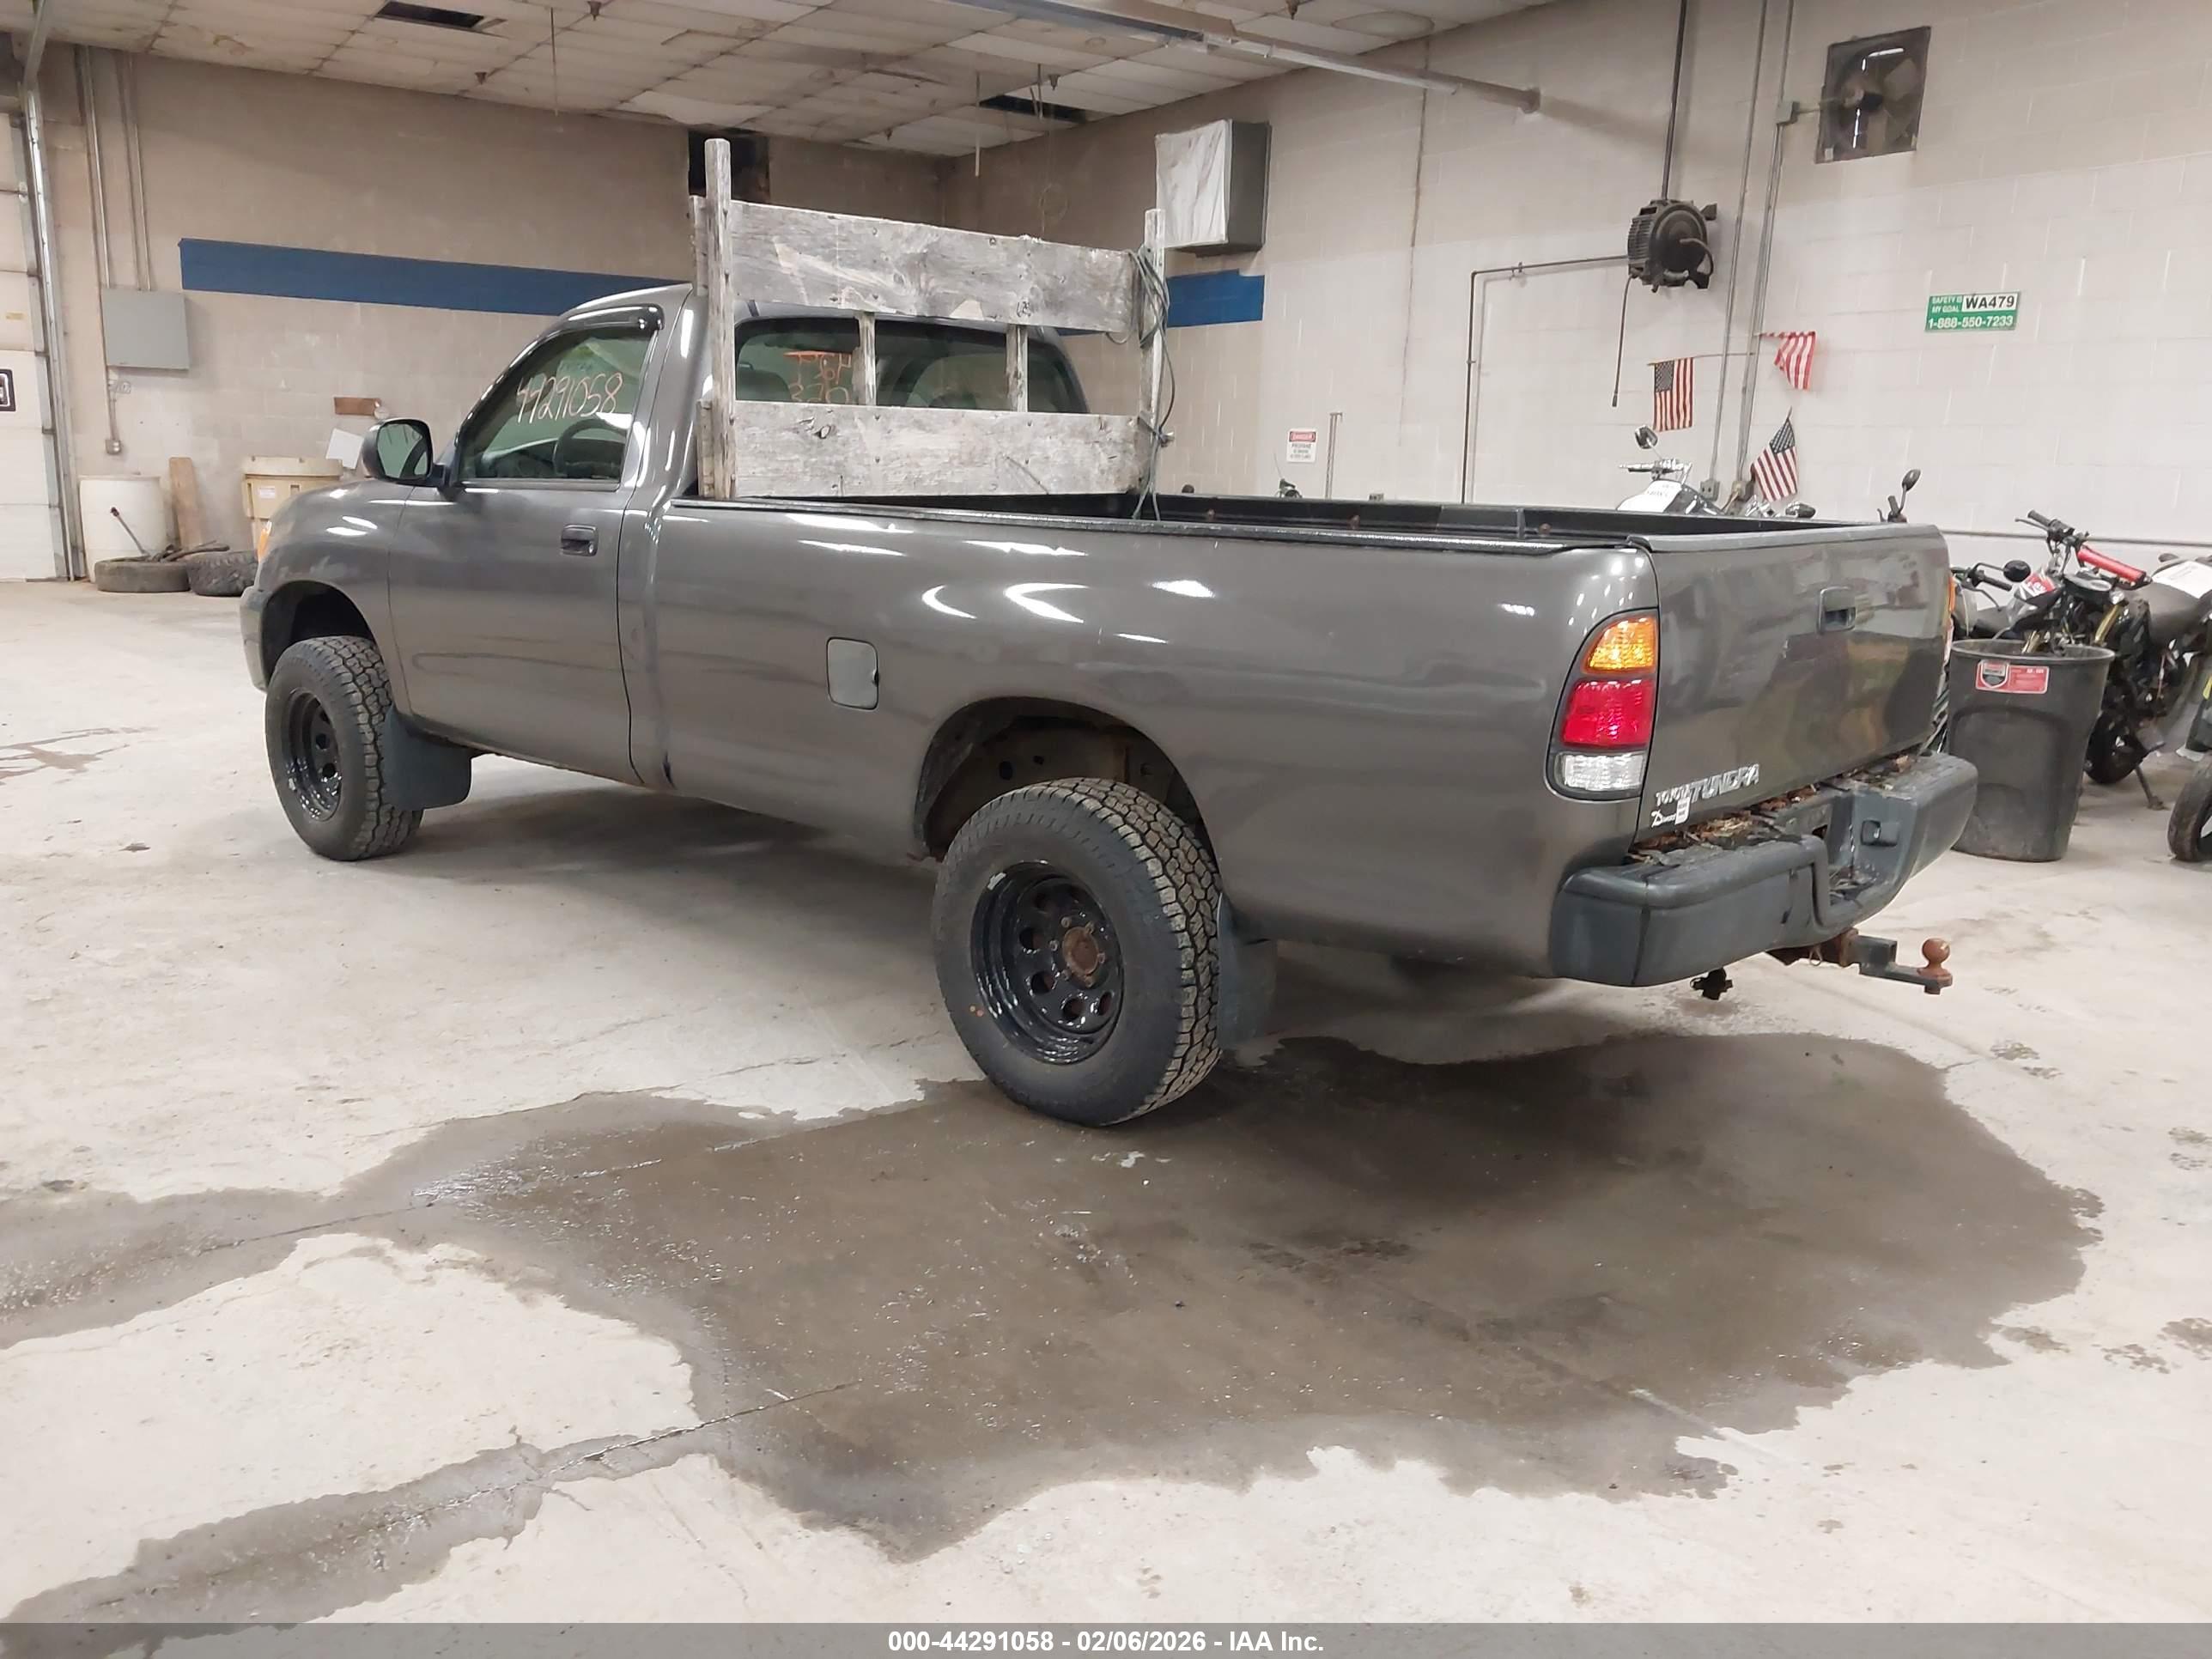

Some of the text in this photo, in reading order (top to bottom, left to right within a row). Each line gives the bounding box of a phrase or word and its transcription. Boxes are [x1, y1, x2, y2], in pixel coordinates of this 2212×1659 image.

[1931, 305, 1942, 313] MY
[1966, 295, 2014, 309] WA479
[1928, 315, 2014, 329] 1-888-550-7233
[516, 372, 623, 424] 44291058
[1689, 763, 1759, 804] TUNDRA
